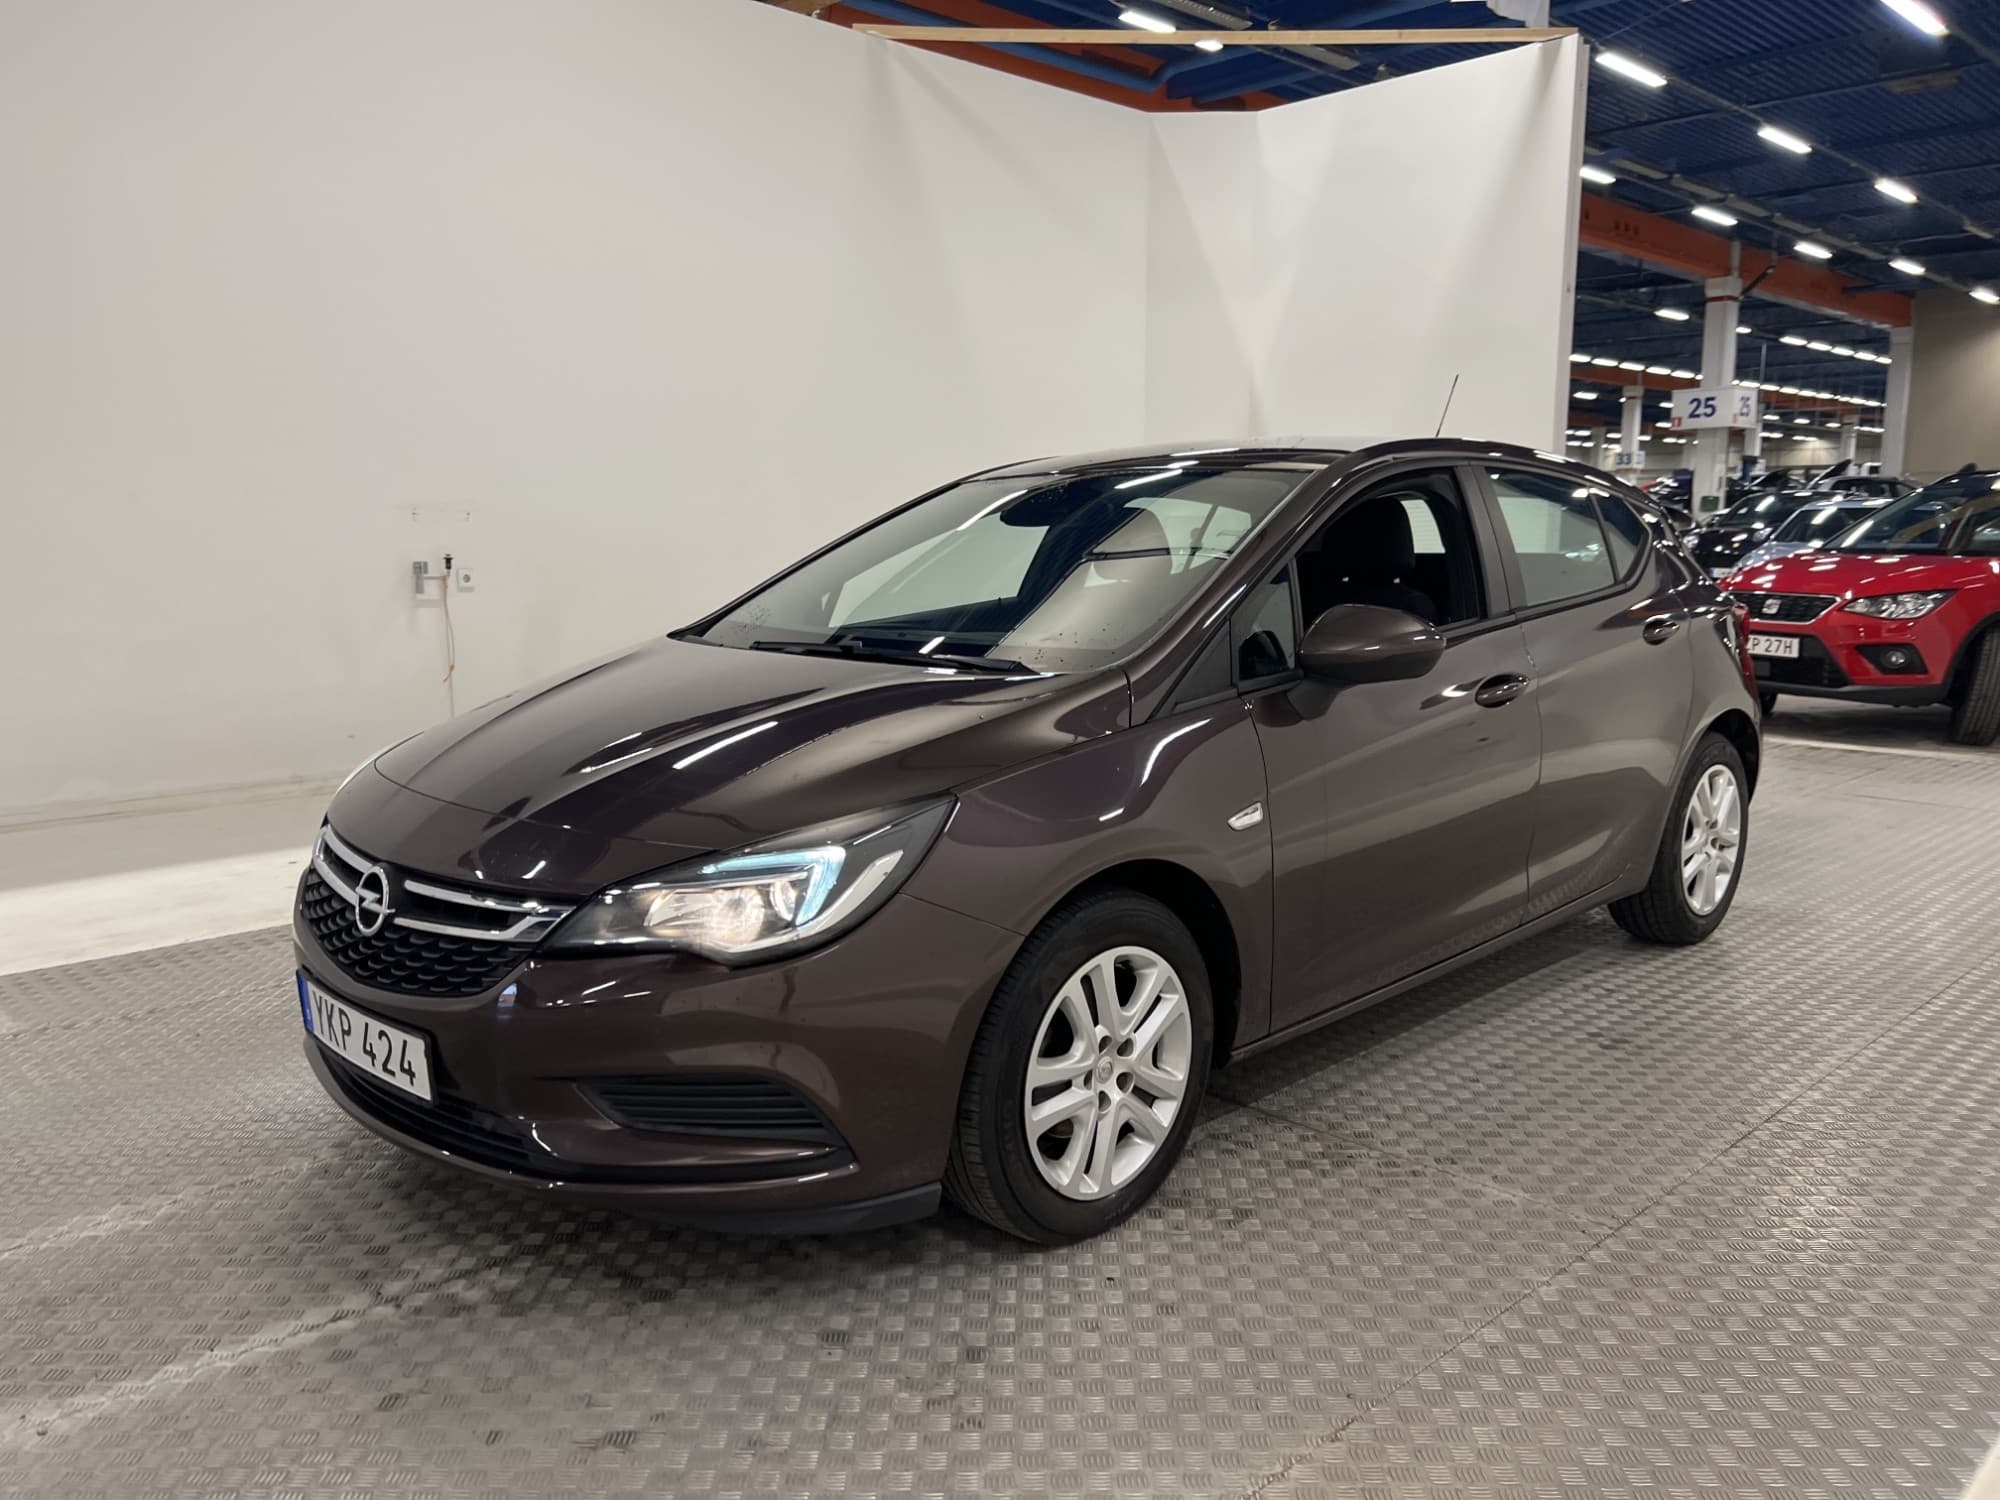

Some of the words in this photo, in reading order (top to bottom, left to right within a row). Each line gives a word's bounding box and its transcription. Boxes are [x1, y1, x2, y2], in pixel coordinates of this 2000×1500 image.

[1687, 396, 1718, 419] 25
[1739, 396, 1751, 417] 25
[1764, 638, 1793, 655] 27H
[311, 989, 352, 1051] YKP
[362, 1022, 416, 1087] 424
